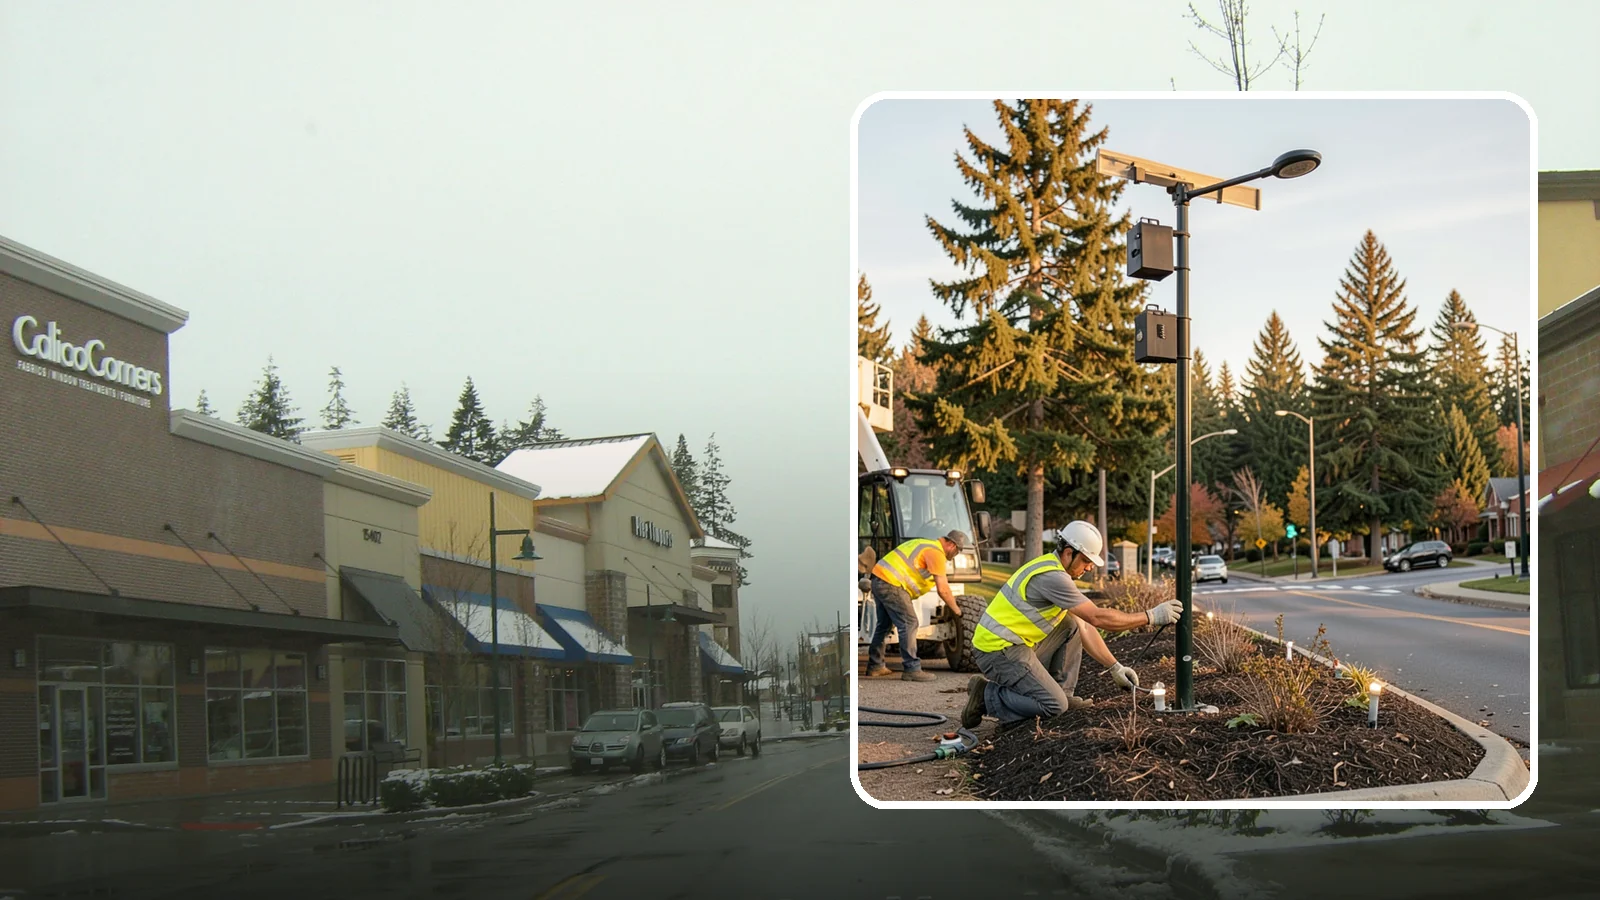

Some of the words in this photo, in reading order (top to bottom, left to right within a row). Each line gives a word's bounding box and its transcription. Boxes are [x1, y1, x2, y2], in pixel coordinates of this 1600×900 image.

[17, 360, 47, 377] FABRICS
[51, 370, 78, 387] WINDOW
[79, 378, 116, 398] TREATMENTS
[120, 391, 151, 409] FURNITURE
